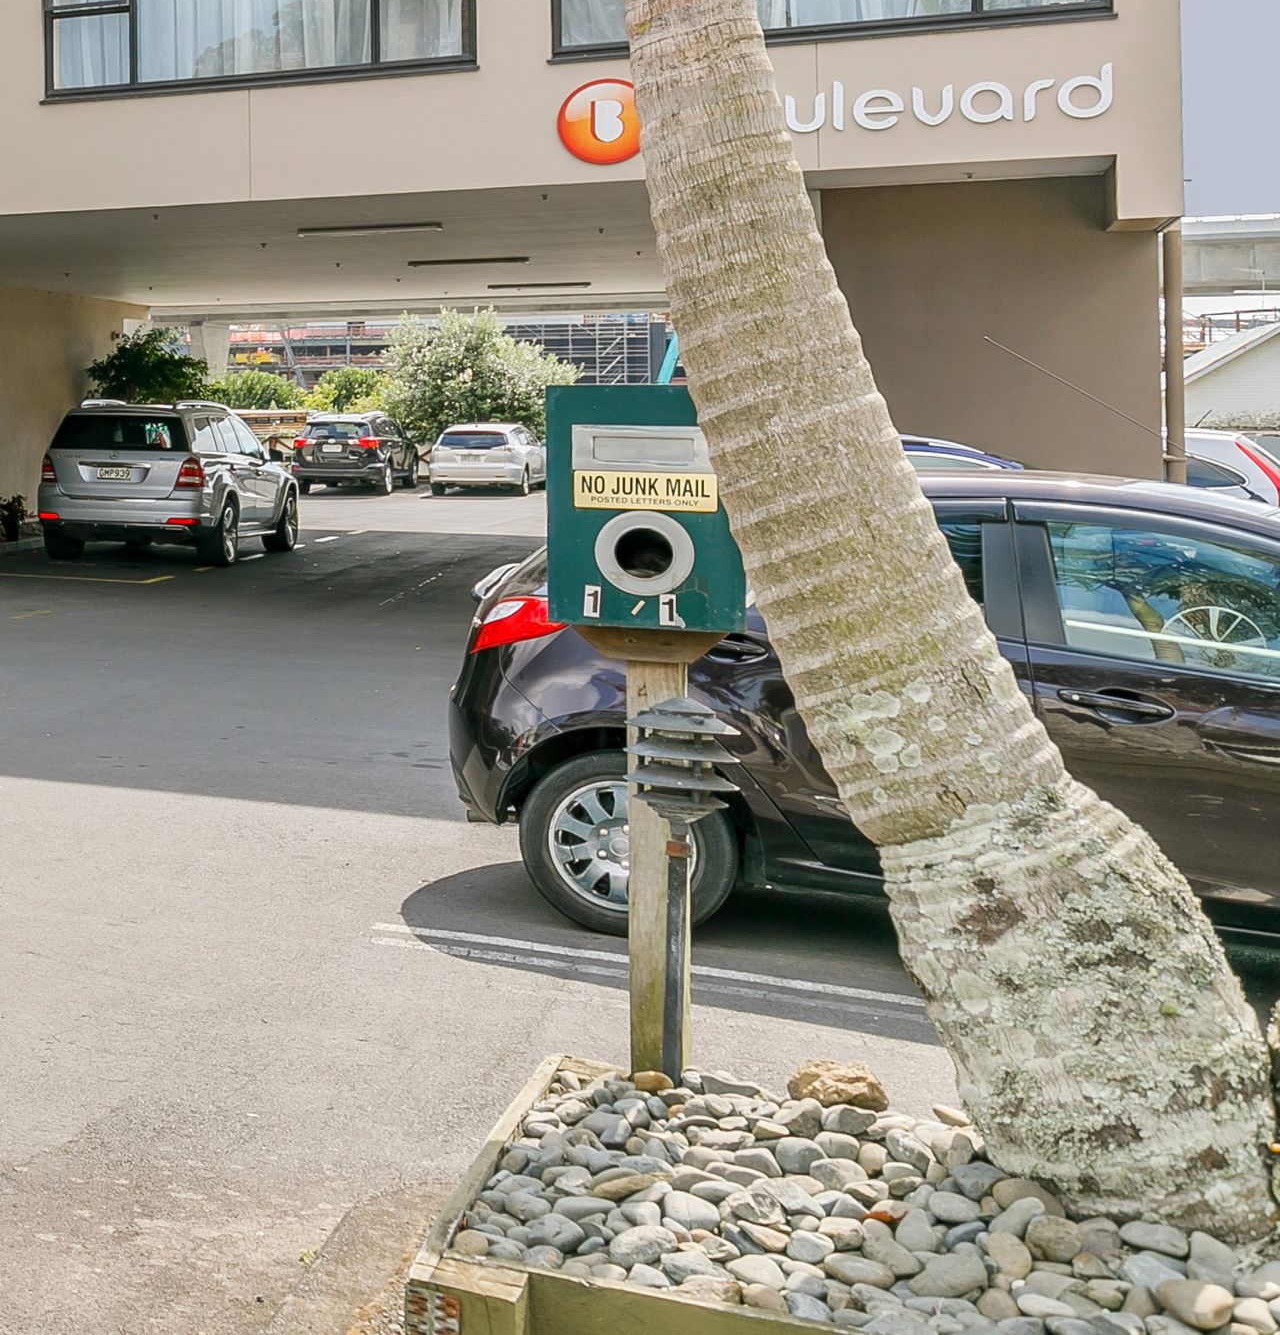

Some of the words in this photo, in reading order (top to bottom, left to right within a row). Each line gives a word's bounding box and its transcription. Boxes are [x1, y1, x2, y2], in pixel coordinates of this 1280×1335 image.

[785, 62, 1114, 133] ulevard
[98, 467, 130, 479] GMP939
[581, 475, 605, 494] NO
[611, 476, 658, 497] JUNK
[666, 478, 710, 498] MAIL
[590, 496, 628, 504] POSTED
[630, 497, 672, 506] LETTERS
[674, 499, 699, 507] ONLY
